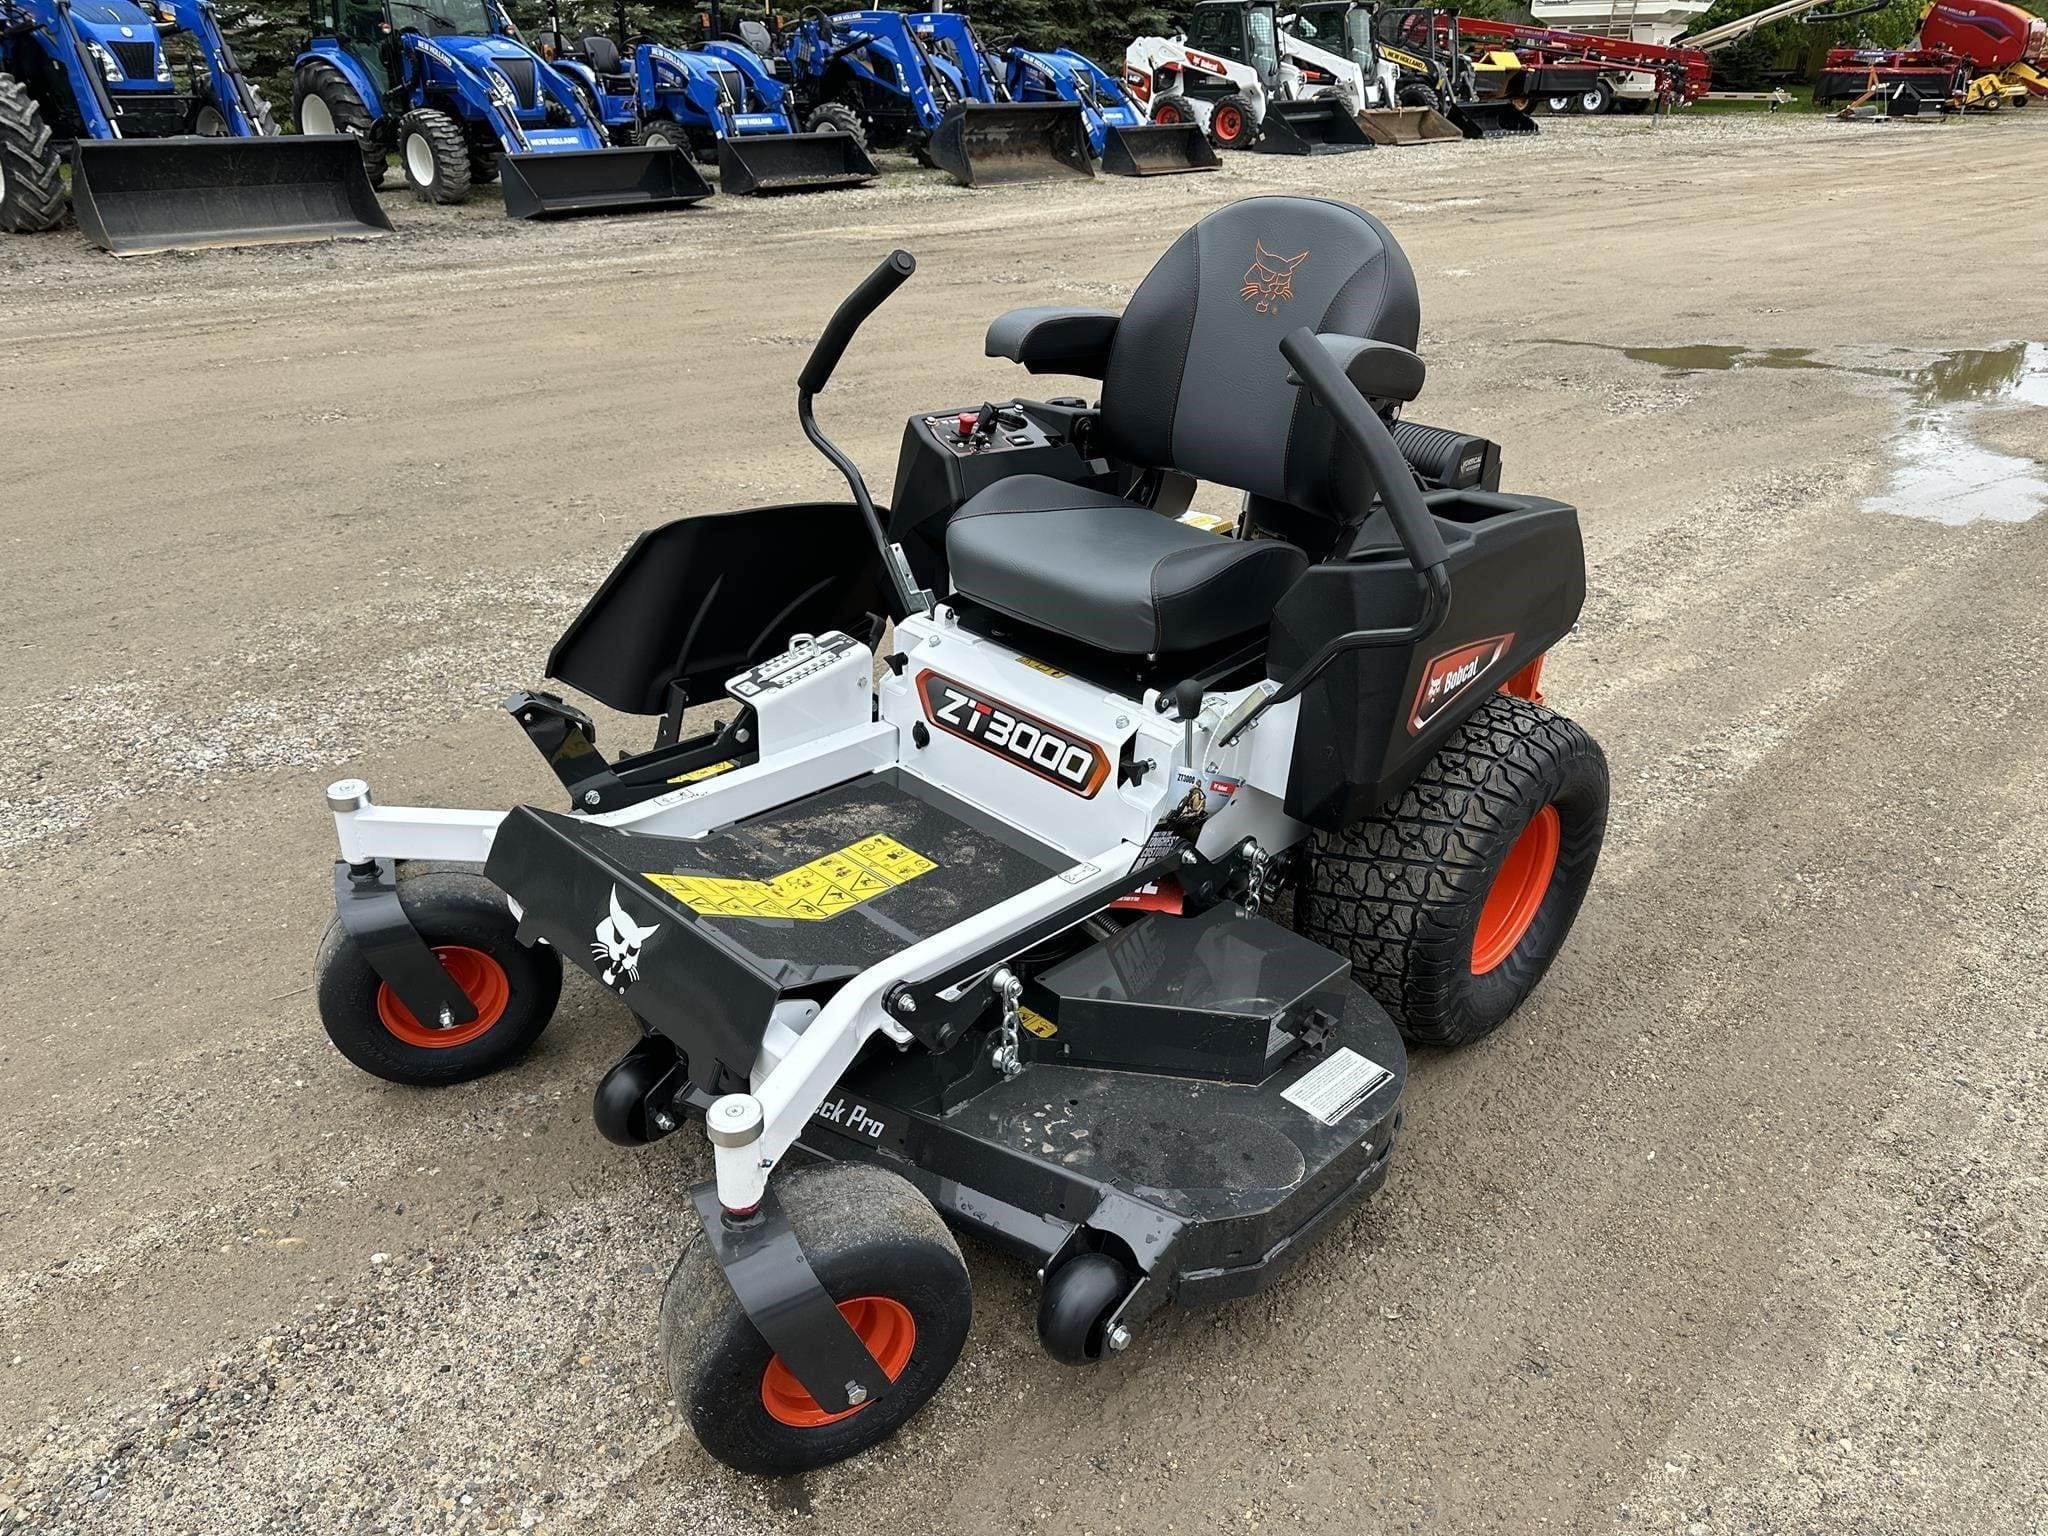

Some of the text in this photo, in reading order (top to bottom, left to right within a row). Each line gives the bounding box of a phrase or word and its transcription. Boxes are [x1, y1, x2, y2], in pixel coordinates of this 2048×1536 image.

[417, 40, 452, 67] NEW HOLLAND
[651, 47, 689, 75] NEW HOLLAND
[1388, 51, 1424, 68] NEW HOLLAND
[1034, 59, 1055, 77] HOLLAND
[1200, 59, 1219, 72] Bobcat
[735, 117, 773, 126] NEW HOLLAND
[530, 136, 579, 146] NEW HOLLAND
[1443, 655, 1479, 694] Bobcat
[936, 688, 1094, 784] ZT3000
[1177, 773, 1196, 785] ZT3000
[845, 1104, 885, 1138] Pro
